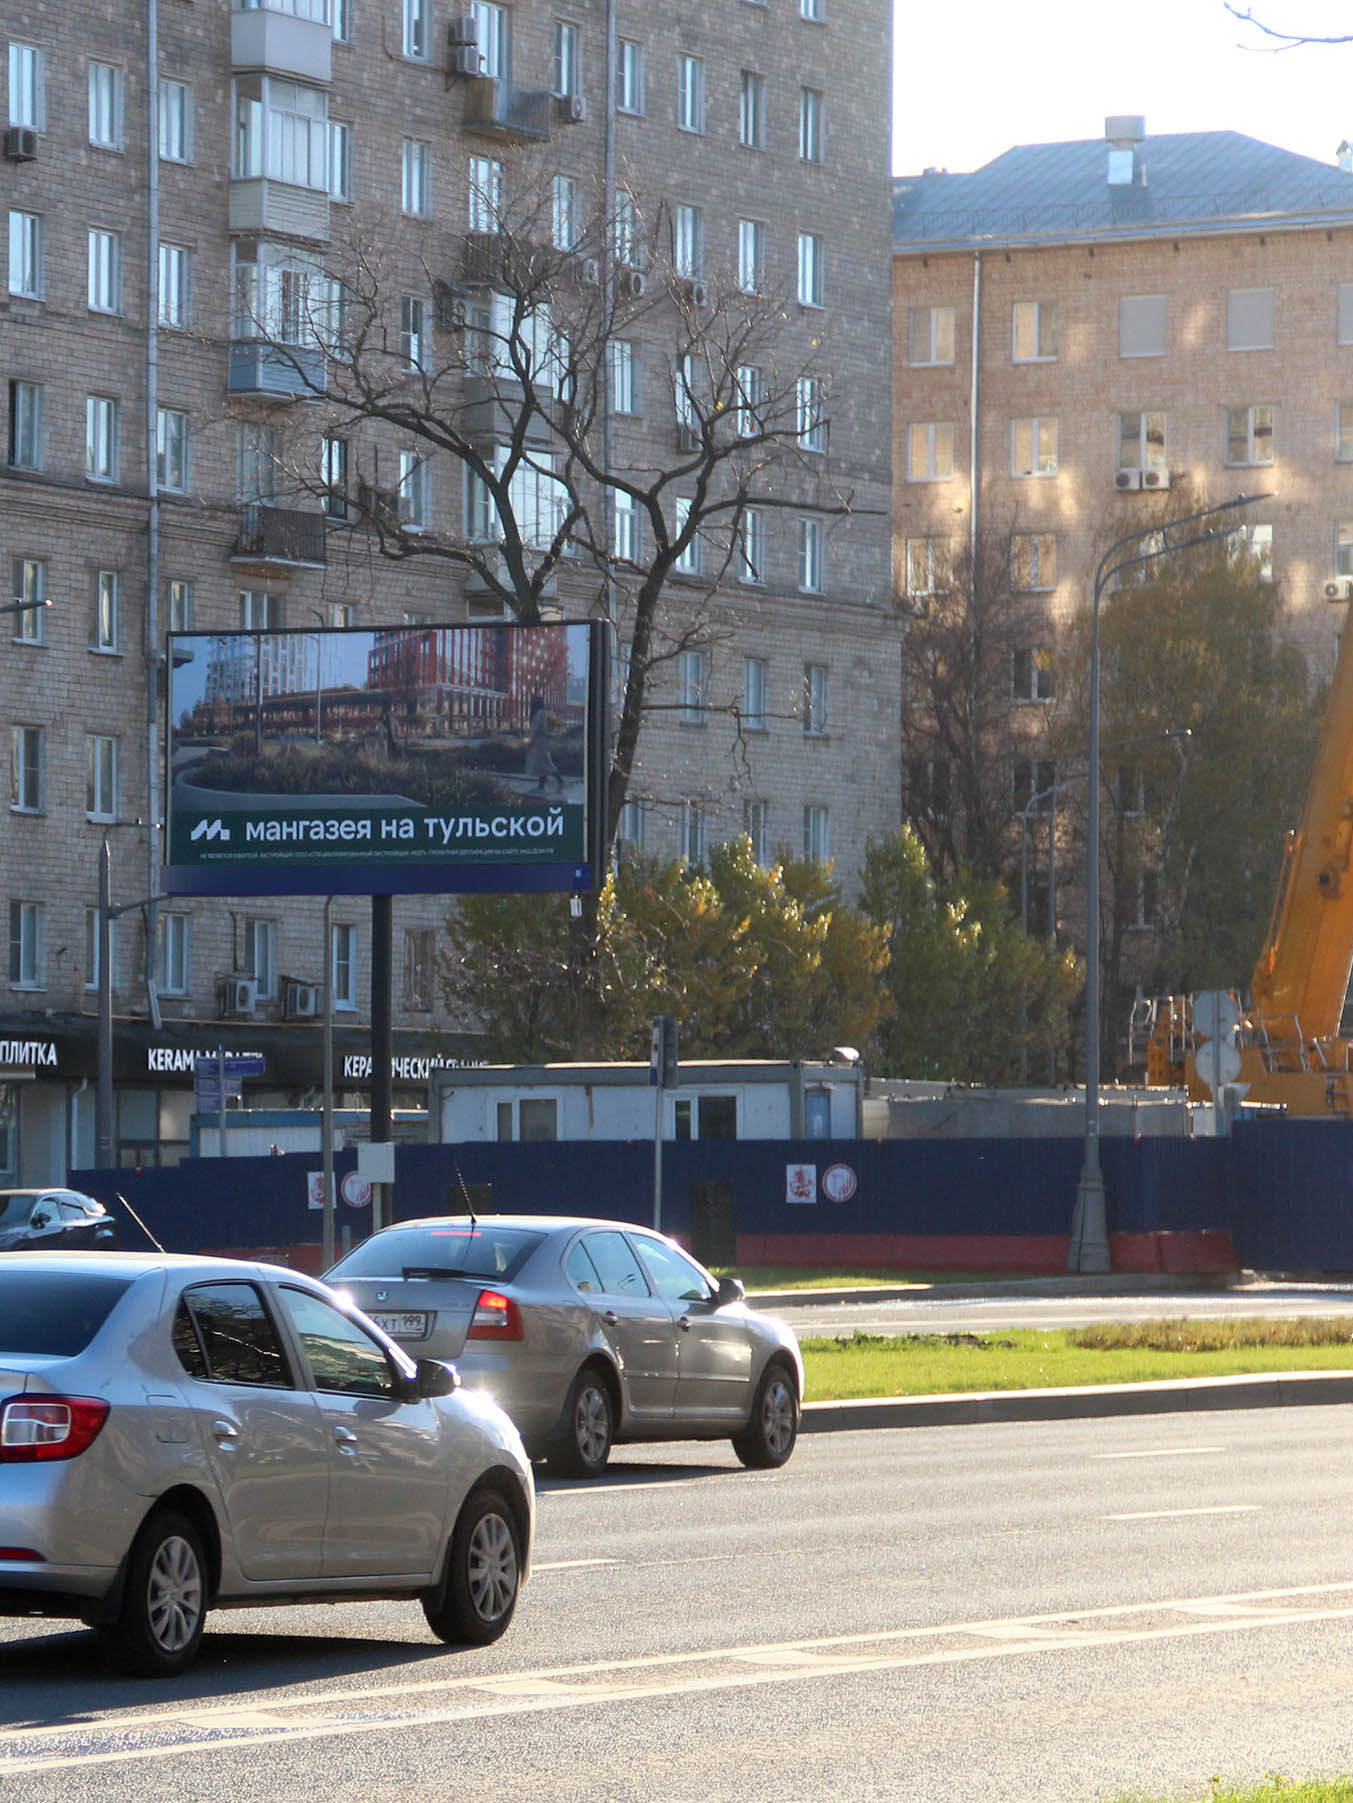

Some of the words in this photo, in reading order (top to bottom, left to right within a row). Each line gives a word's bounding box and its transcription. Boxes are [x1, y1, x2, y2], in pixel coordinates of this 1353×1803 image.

[246, 819, 372, 842] мангазея
[381, 818, 414, 840] на
[424, 807, 564, 844] тульской
[0, 1040, 58, 1066] ПЛИТКА
